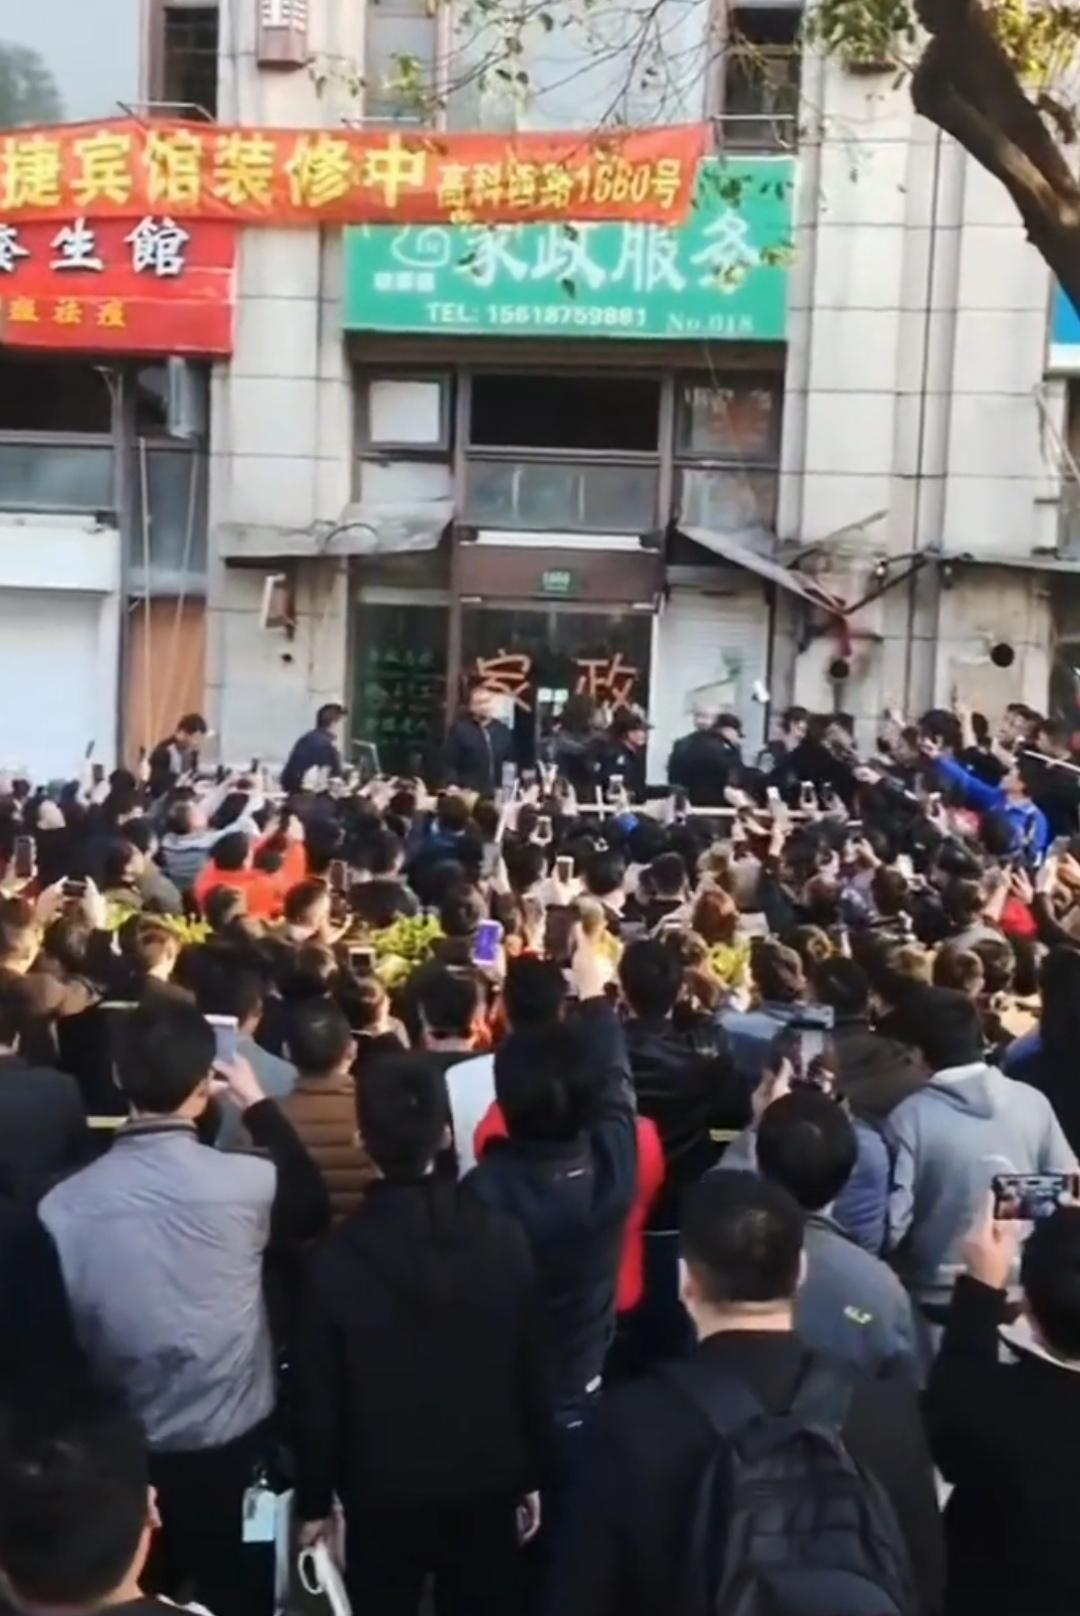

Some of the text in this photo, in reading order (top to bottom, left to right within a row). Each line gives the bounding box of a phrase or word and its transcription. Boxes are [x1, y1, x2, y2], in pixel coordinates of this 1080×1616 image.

[0, 129, 426, 208] 捷宾馆装修中
[453, 209, 762, 295] 家政服务
[426, 302, 478, 323] TEL:
